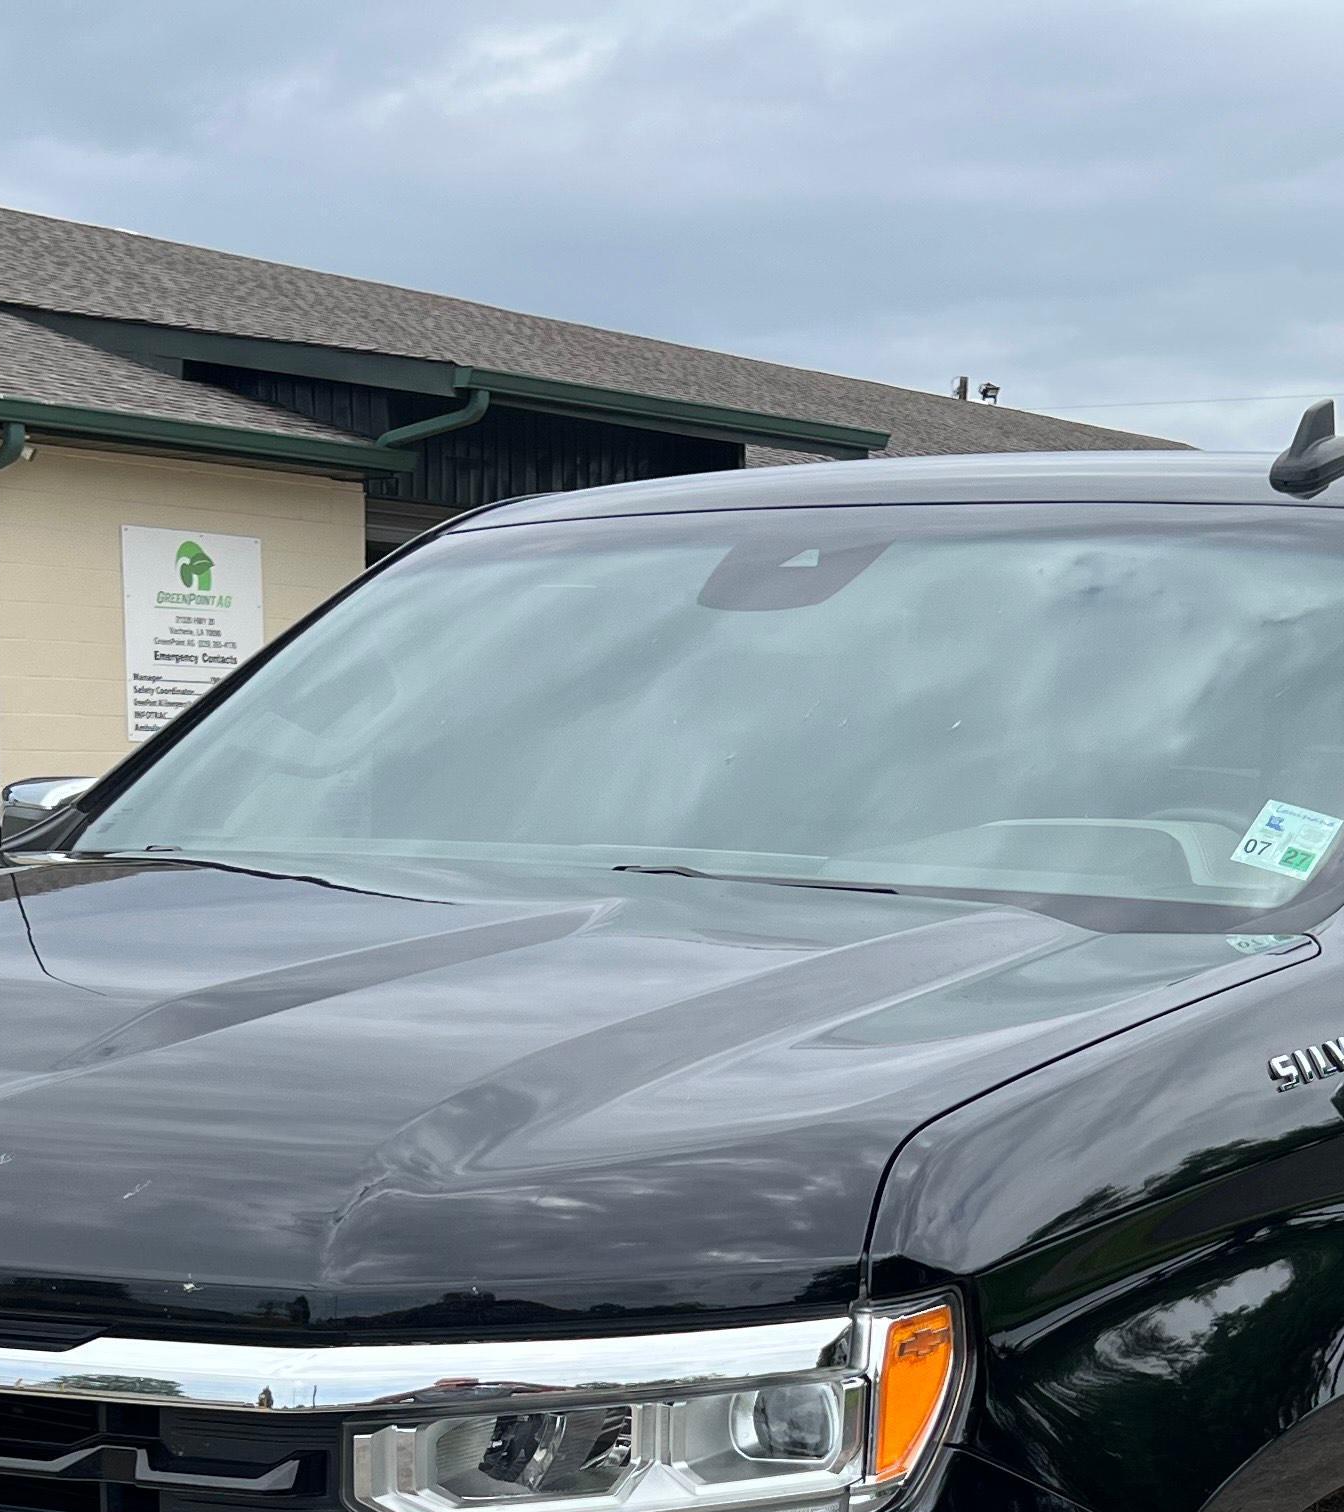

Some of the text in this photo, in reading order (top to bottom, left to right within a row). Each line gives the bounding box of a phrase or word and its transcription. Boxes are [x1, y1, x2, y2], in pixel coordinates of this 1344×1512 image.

[216, 595, 232, 608] AG
[154, 651, 237, 664] Emergency Contacts
[133, 673, 162, 683] Manager
[134, 686, 194, 696] Safety Coordinator
[1243, 838, 1272, 856] 07
[1283, 848, 1313, 867] 27
